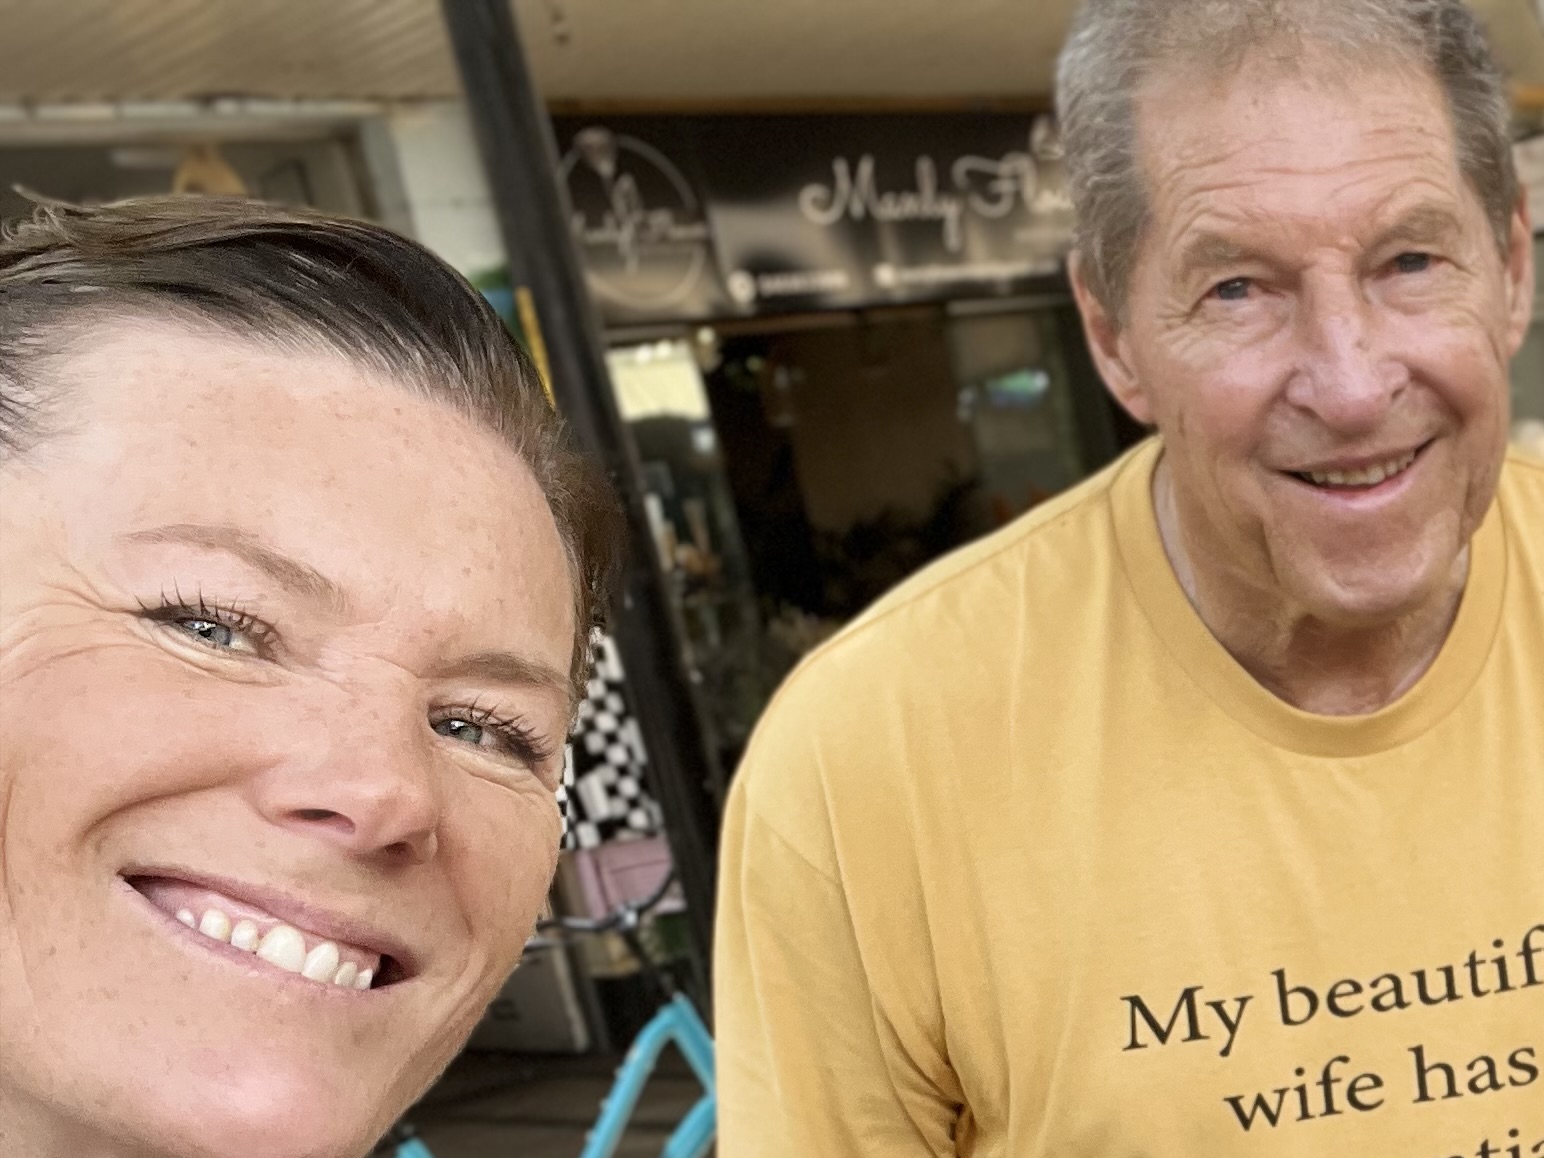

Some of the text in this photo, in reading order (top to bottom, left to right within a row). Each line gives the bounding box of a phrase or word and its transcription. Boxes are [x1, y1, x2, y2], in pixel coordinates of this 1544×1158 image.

[1120, 985, 1254, 1058] My
[1223, 1044, 1540, 1132] wife has
